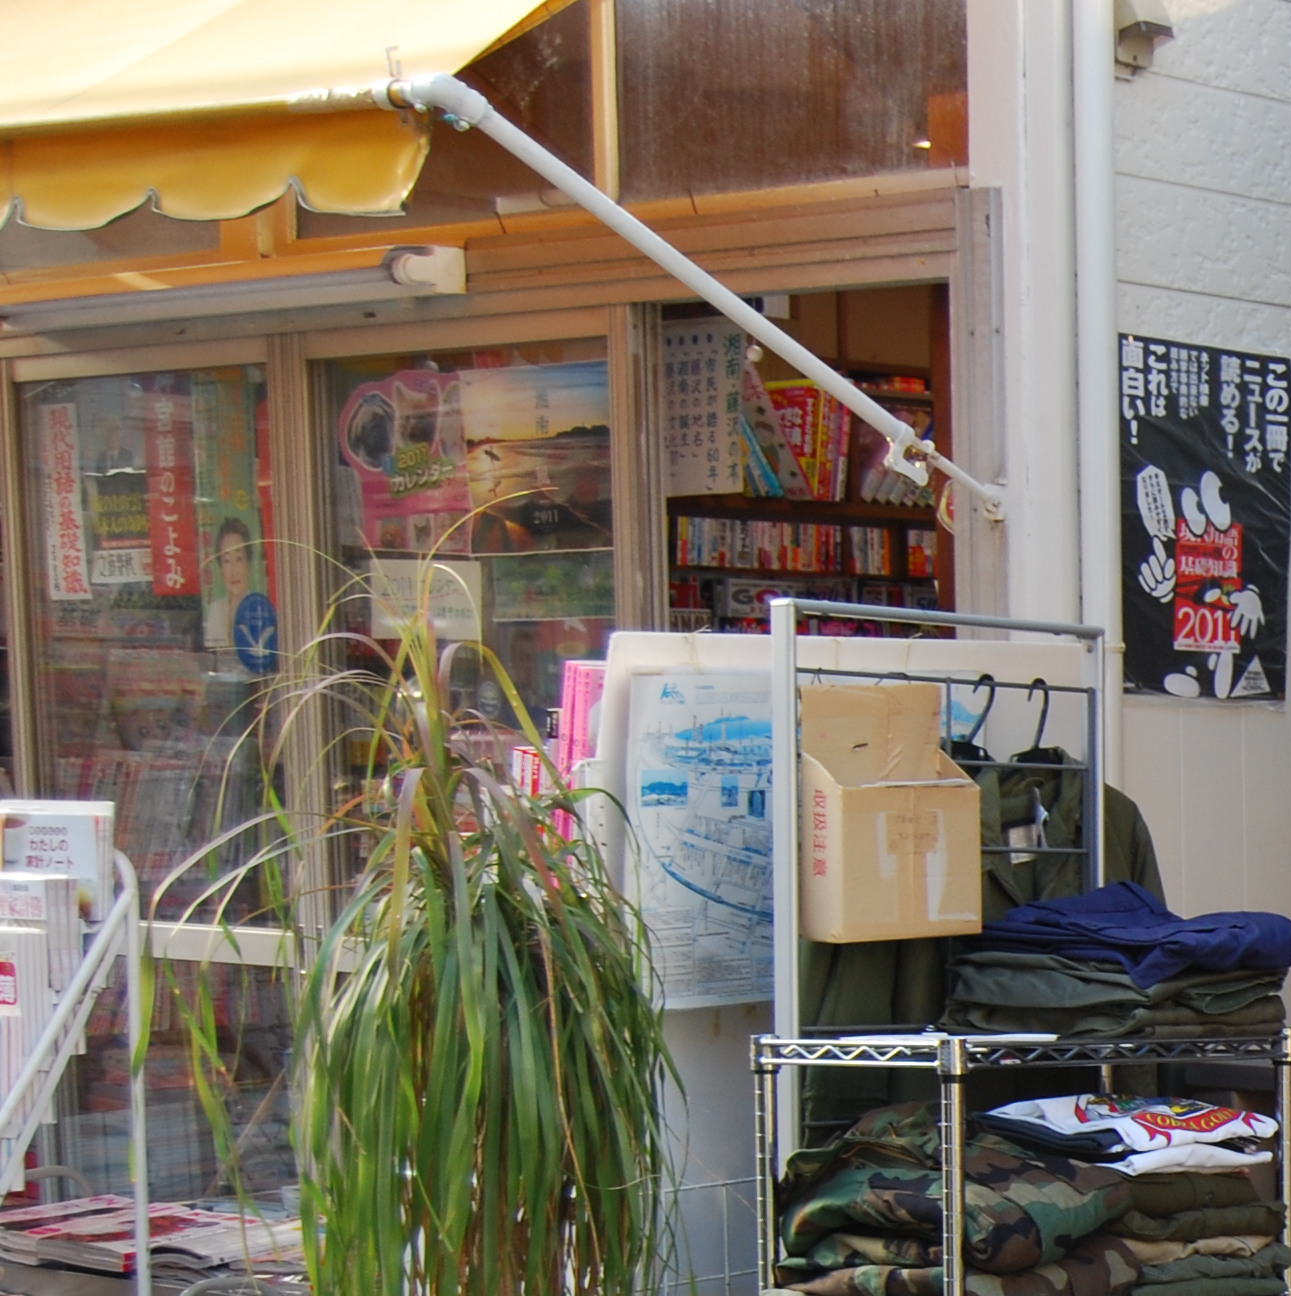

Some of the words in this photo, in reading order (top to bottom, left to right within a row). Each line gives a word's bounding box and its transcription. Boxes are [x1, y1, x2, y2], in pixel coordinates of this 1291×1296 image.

[1147, 343, 1169, 418] これは
[1243, 359, 1264, 474] ニュースが
[1265, 362, 1290, 474] この一冊で
[533, 509, 559, 524] 2011
